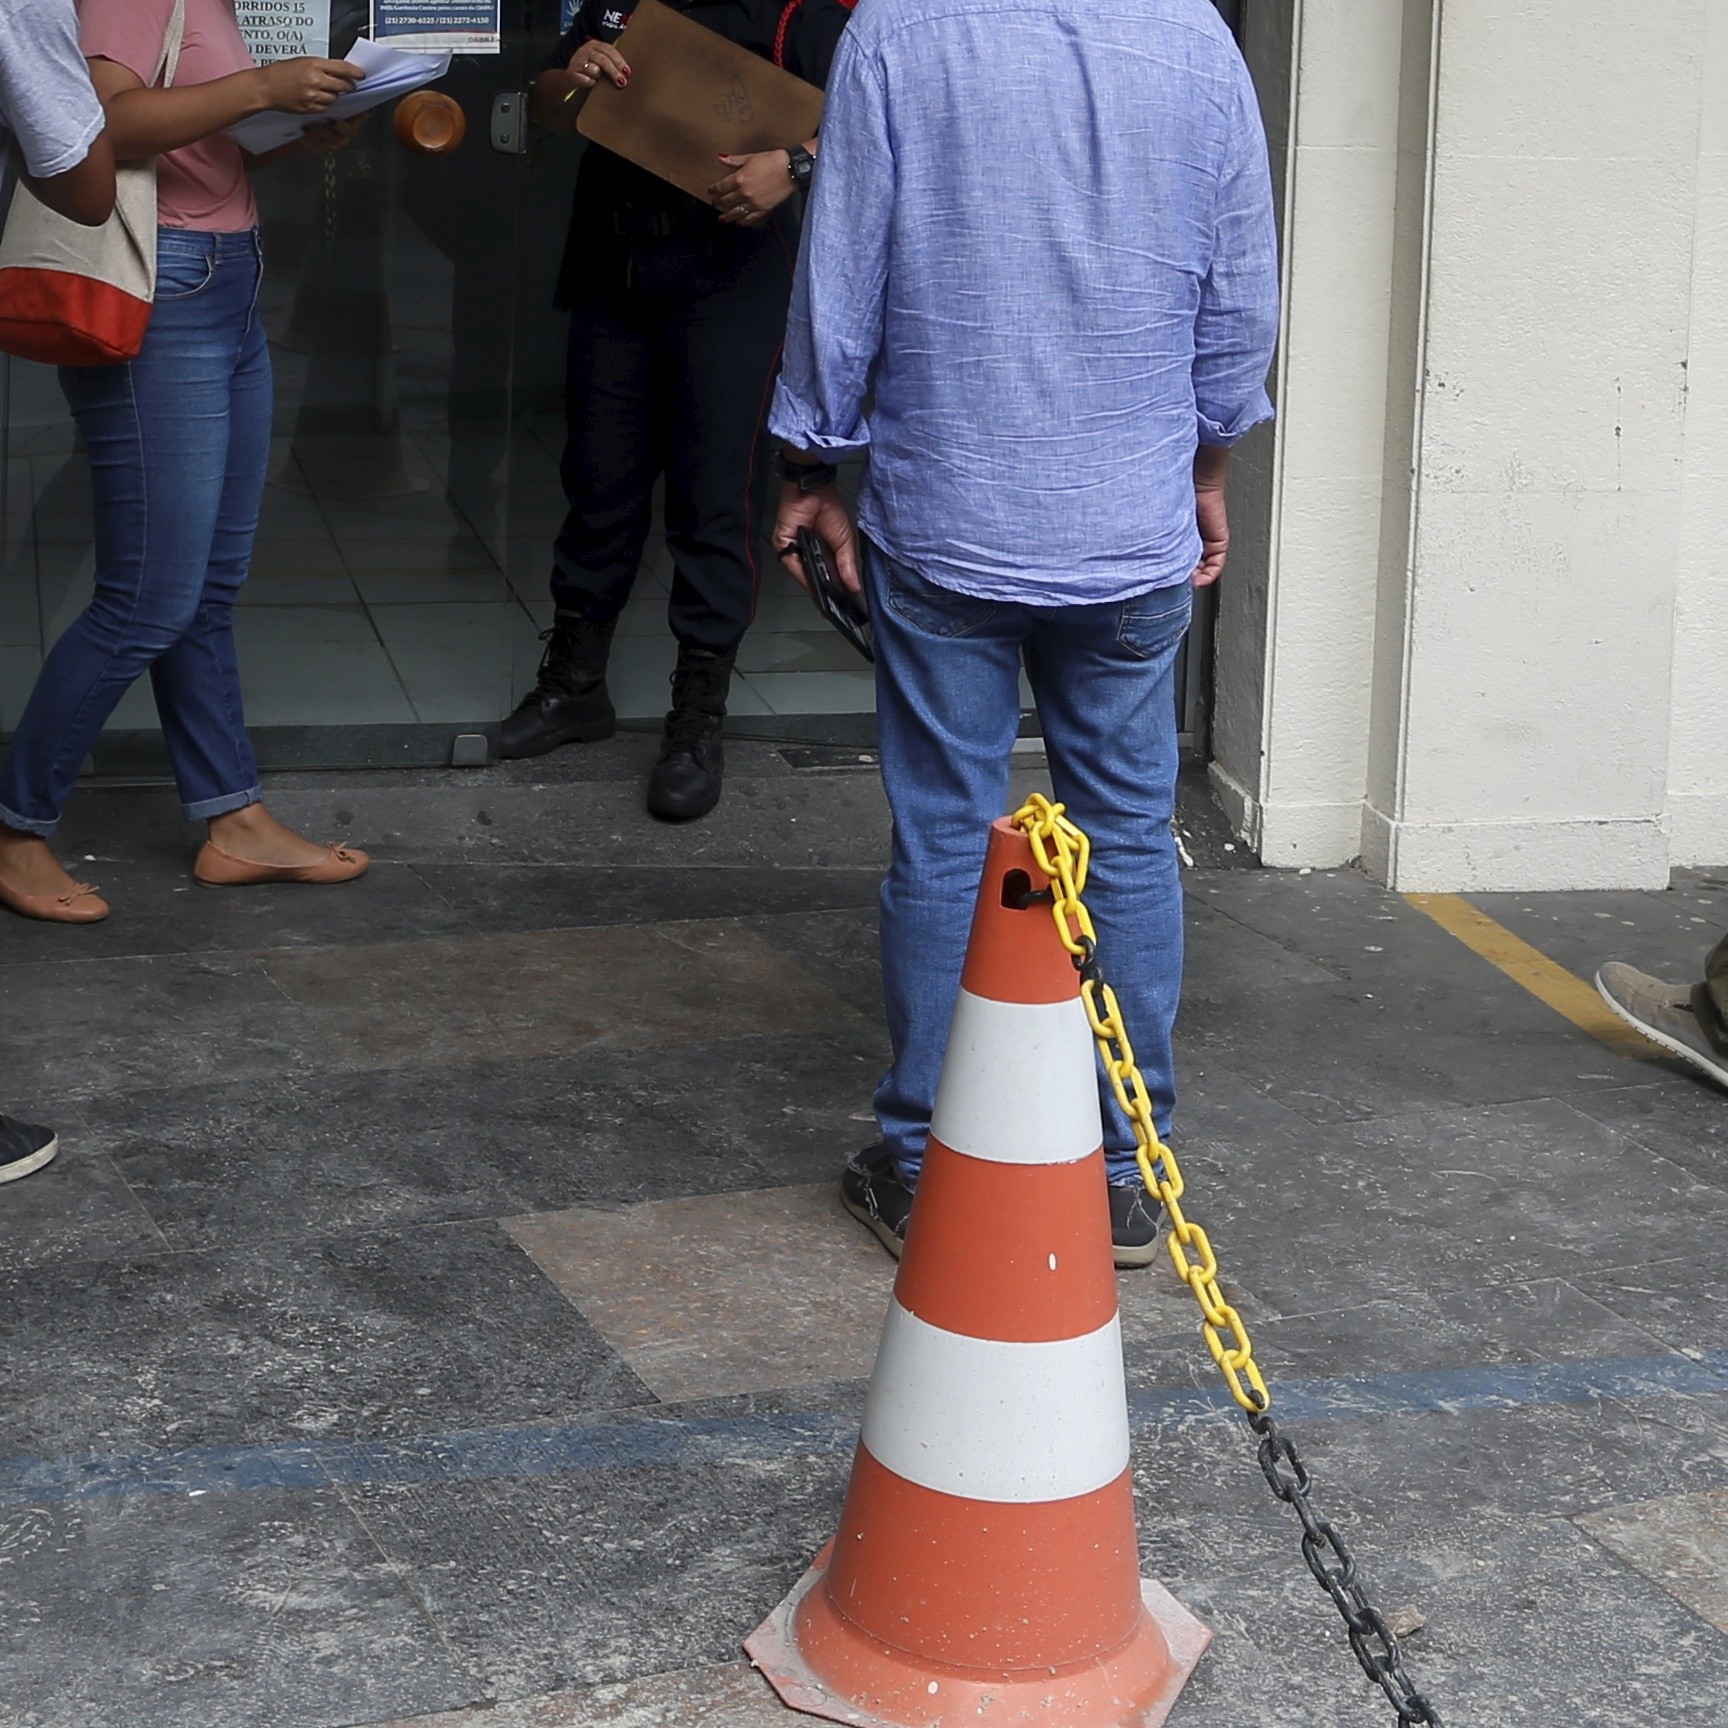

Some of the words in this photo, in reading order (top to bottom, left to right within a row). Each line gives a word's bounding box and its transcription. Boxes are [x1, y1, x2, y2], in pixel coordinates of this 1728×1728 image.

[234, 1, 290, 13] ORRIDOS
[292, 2, 306, 13] 15
[242, 15, 292, 27] ATRASO
[295, 17, 314, 27] DO
[276, 30, 303, 42] O(A)
[255, 43, 308, 55] DEVERÁ
